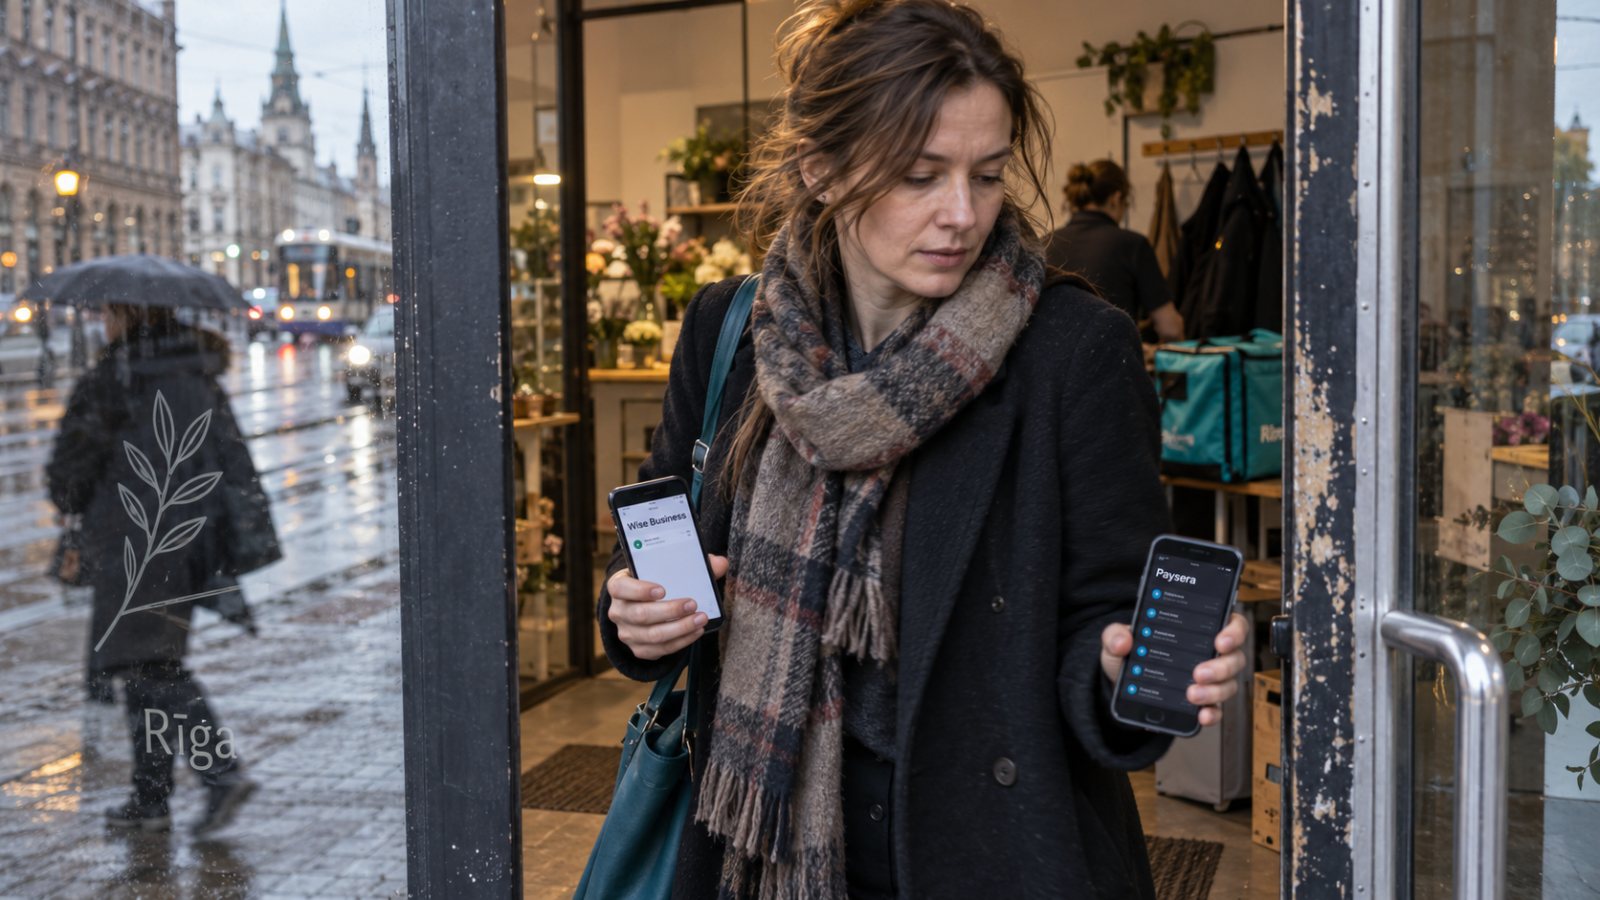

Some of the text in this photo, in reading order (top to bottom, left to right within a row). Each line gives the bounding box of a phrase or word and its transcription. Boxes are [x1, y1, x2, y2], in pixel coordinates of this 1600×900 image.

[627, 512, 687, 531] Wise Business
[1155, 568, 1197, 585] Paysera
[144, 708, 238, 771] Rīga
